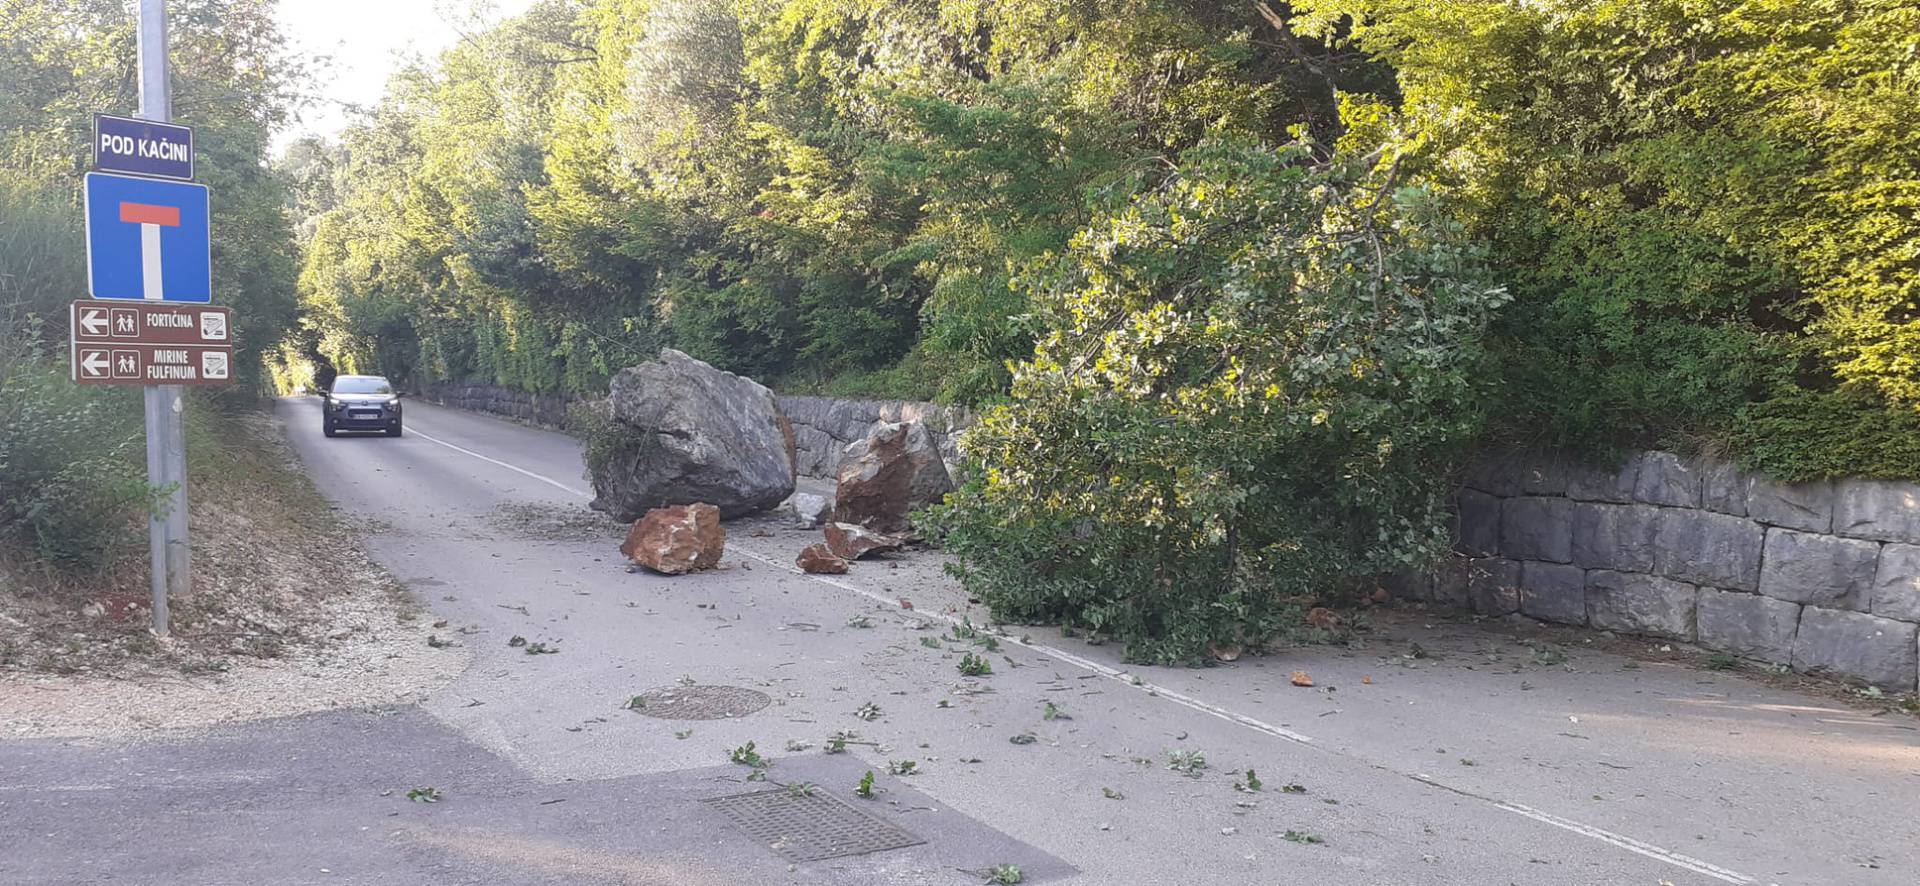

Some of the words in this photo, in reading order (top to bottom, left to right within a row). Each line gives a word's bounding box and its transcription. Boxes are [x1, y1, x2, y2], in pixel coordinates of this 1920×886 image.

[101, 133, 134, 155] POD
[138, 137, 188, 163] KAČINI
[146, 310, 194, 328] FORTIČINA
[153, 350, 189, 364] MIRINE
[147, 365, 197, 380] FULFINUM
